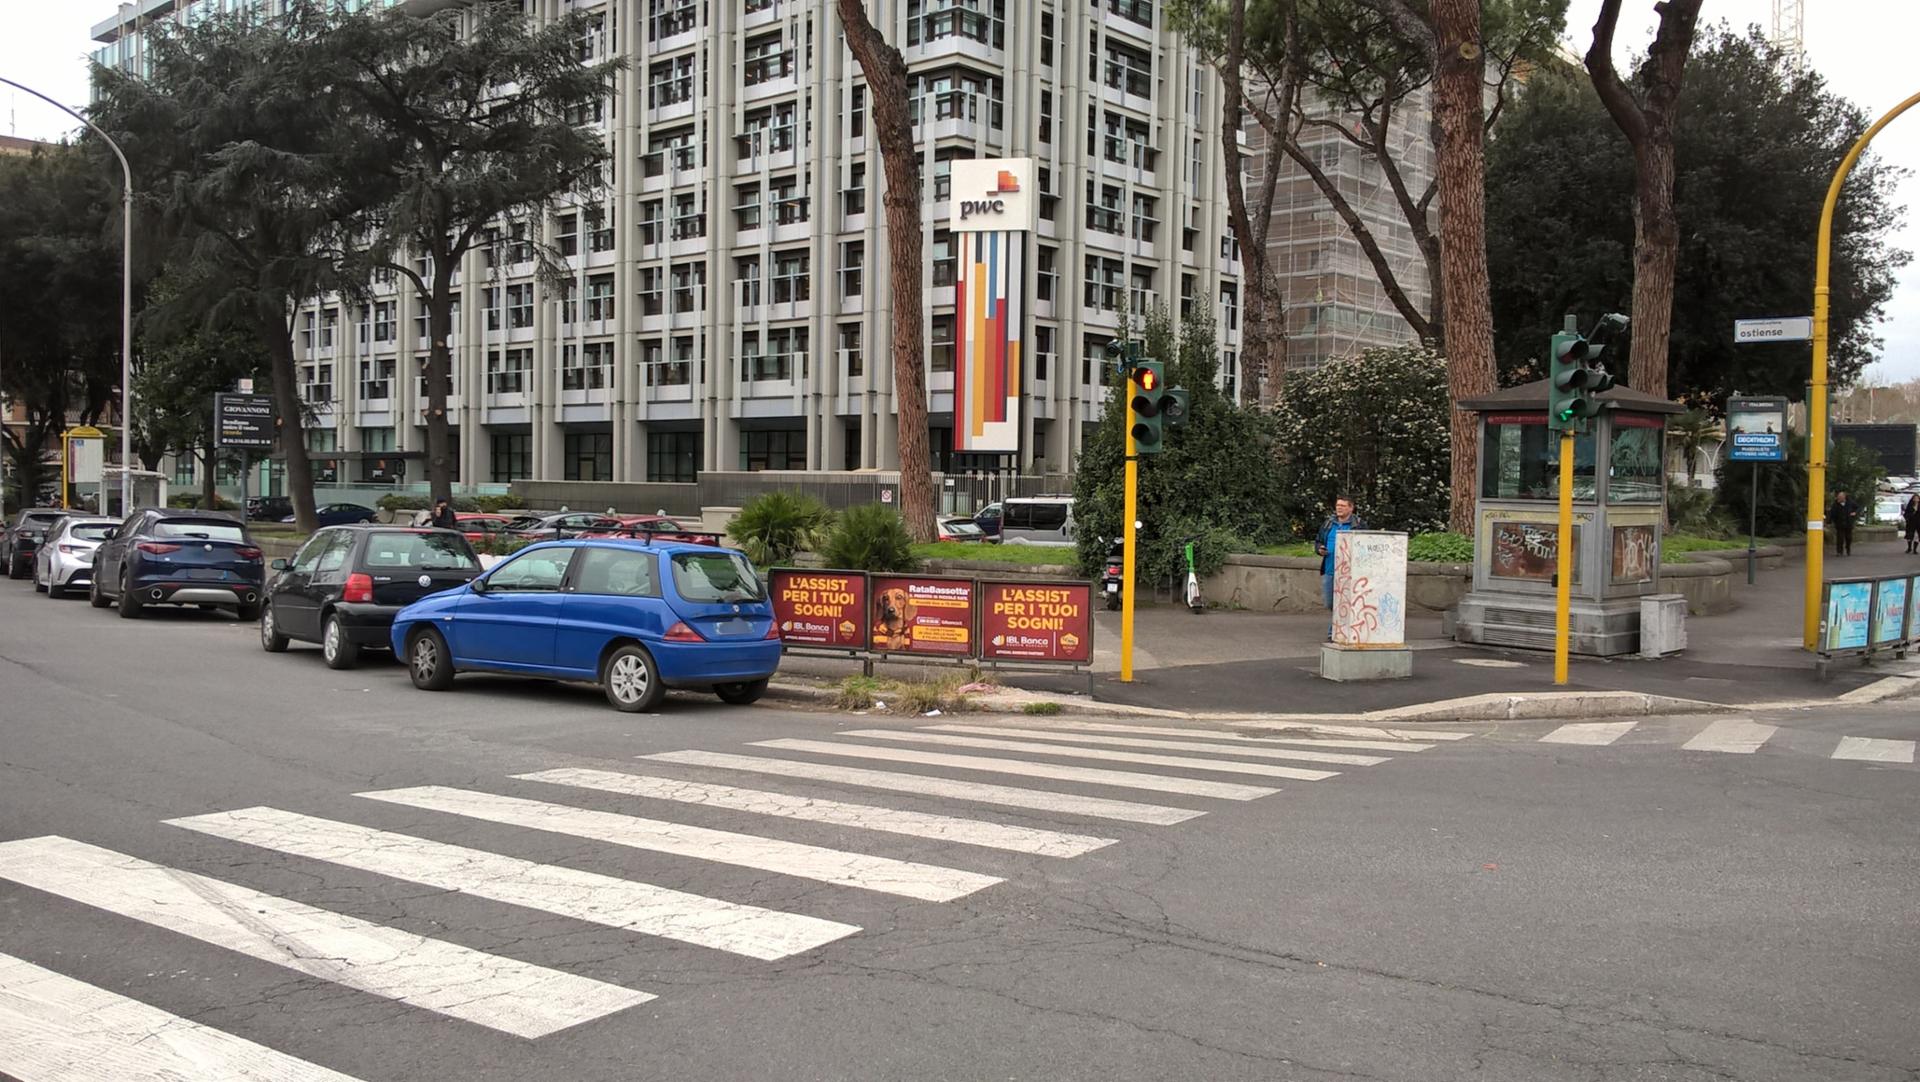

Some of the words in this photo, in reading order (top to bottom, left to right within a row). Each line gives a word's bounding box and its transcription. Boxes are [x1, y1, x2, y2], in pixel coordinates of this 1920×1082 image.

[960, 200, 1004, 220] pwc
[1740, 328, 1783, 337] ostiense
[790, 577, 848, 591] L'ASSIST
[783, 590, 809, 602] PER
[813, 592, 817, 603] I
[820, 592, 855, 605] TUOI
[1002, 588, 1070, 603] L'ASSIST
[794, 604, 842, 618] SOGNI!
[994, 602, 1025, 615] PER
[1030, 604, 1034, 616] I
[1039, 604, 1078, 617] TUOI
[1008, 616, 1064, 630] SOGNI!
[1006, 636, 1019, 644] IBL
